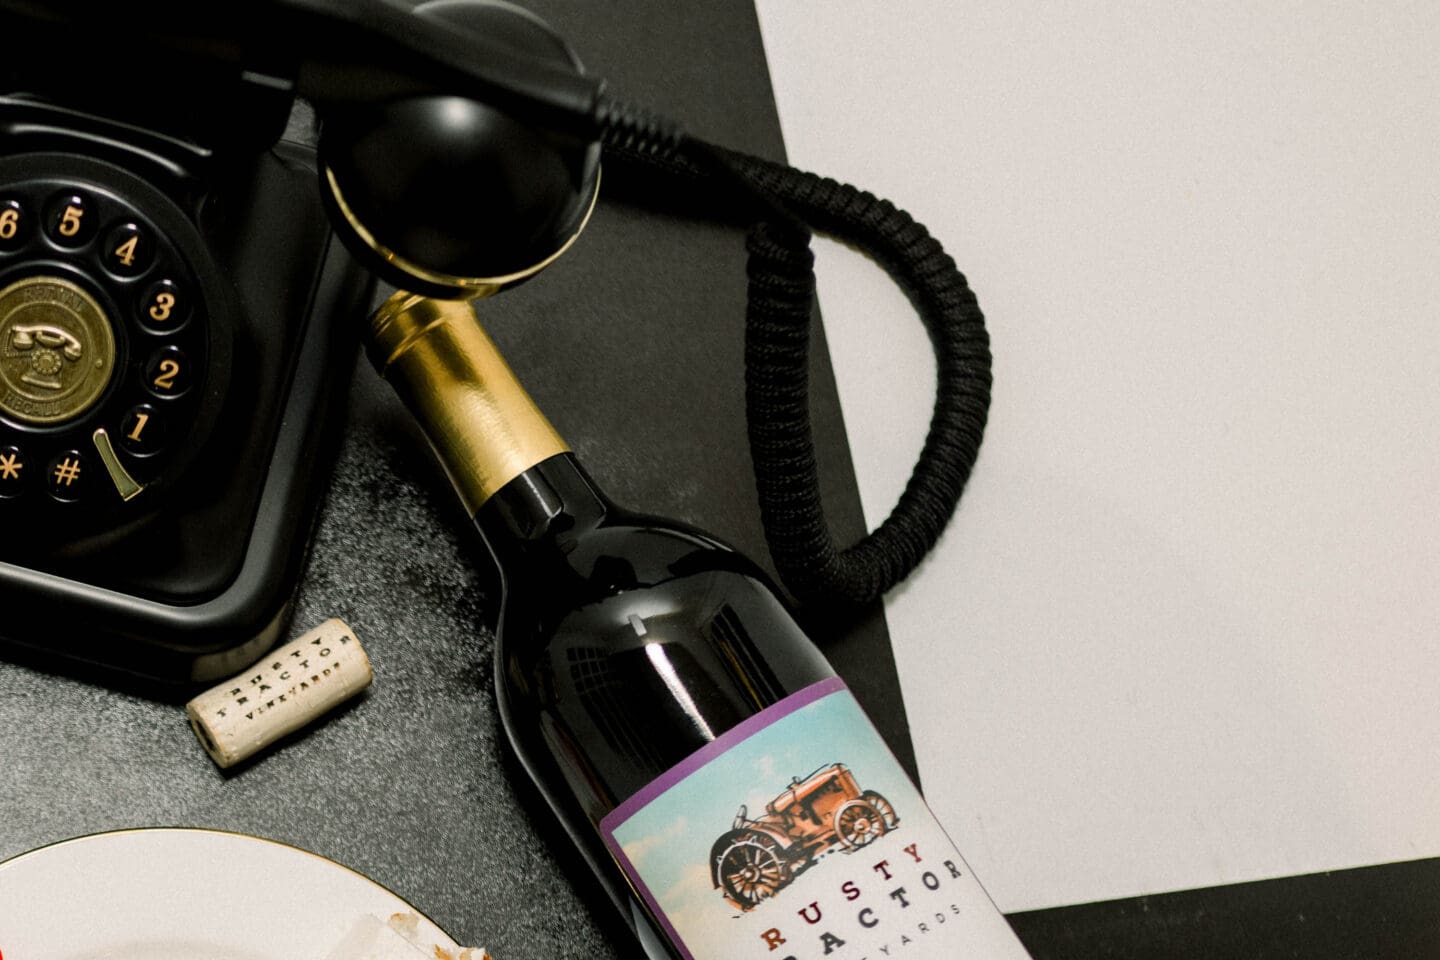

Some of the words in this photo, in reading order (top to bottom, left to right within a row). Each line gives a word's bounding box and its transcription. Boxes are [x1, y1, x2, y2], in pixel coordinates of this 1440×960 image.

[59, 207, 84, 236] 5
[115, 236, 140, 266] 4
[149, 292, 175, 321] 3
[154, 359, 180, 390] 2
[127, 412, 150, 442] 1
[54, 457, 81, 486] #
[760, 843, 923, 952] RUSTY
